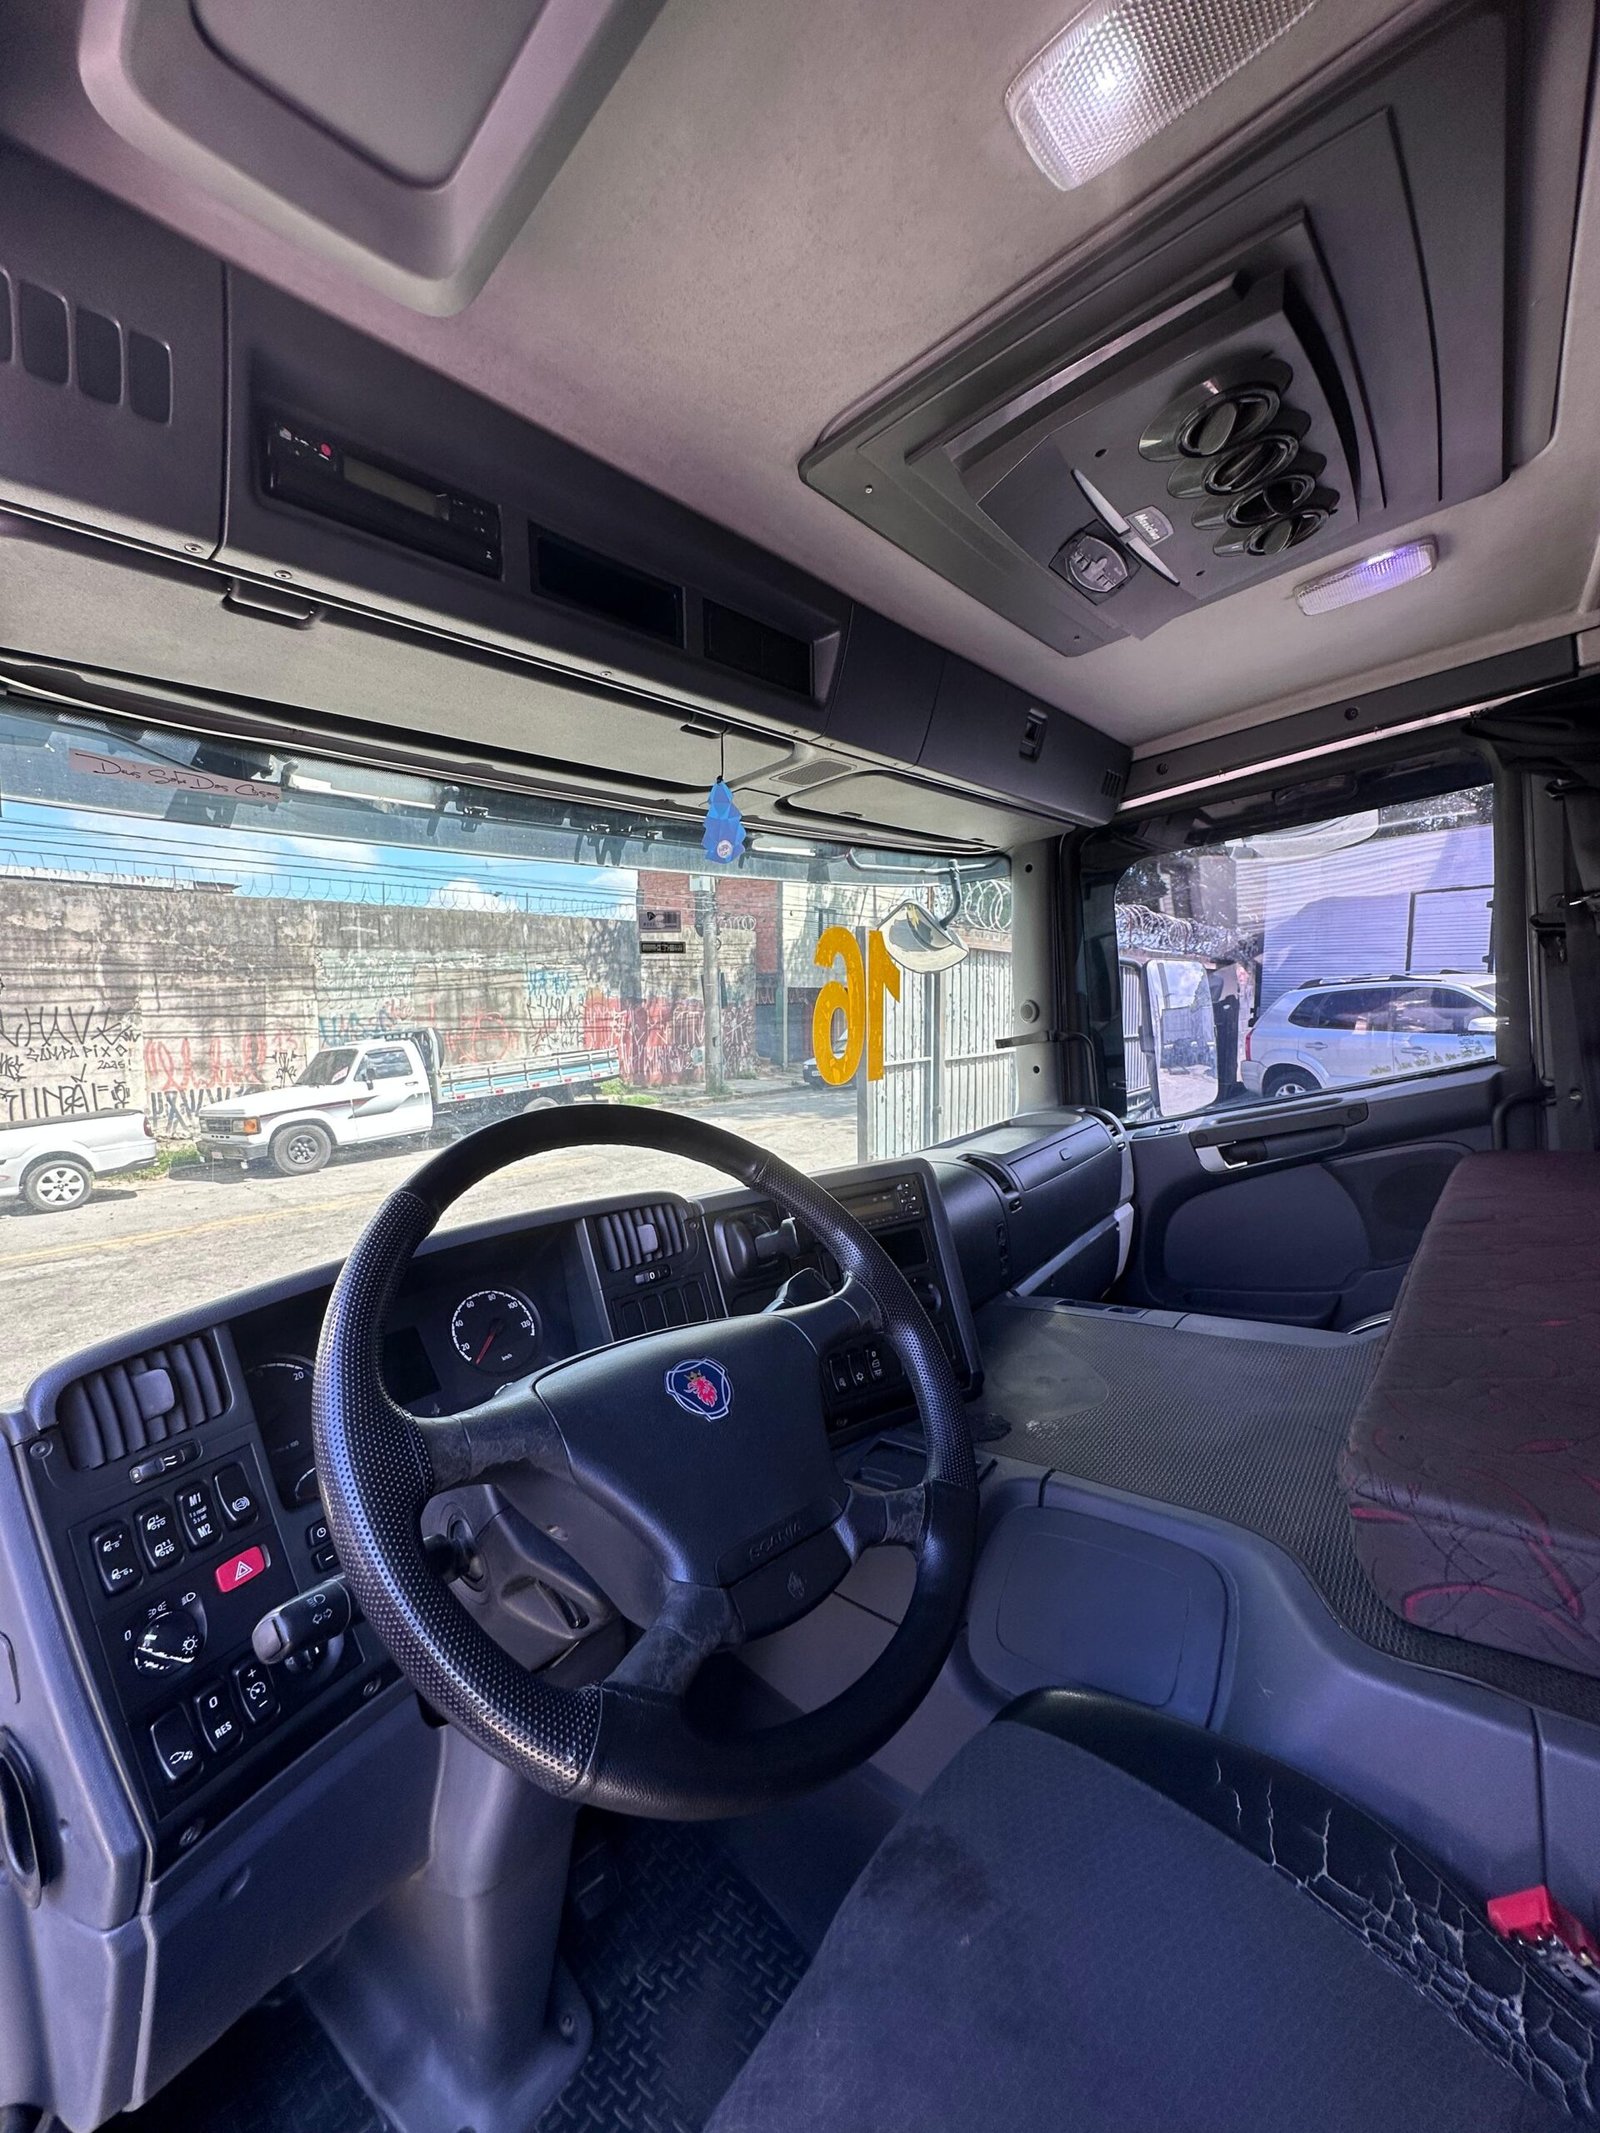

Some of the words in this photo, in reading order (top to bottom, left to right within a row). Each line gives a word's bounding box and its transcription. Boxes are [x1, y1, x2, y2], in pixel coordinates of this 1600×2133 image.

[507, 1301, 518, 1309] 100
[520, 1320, 531, 1328] 120
[461, 1343, 470, 1351] 20
[293, 1371, 304, 1382] 20
[189, 1492, 202, 1507] M1
[197, 1523, 213, 1538] M2
[208, 1696, 219, 1709] 0
[214, 1720, 233, 1739] RES
